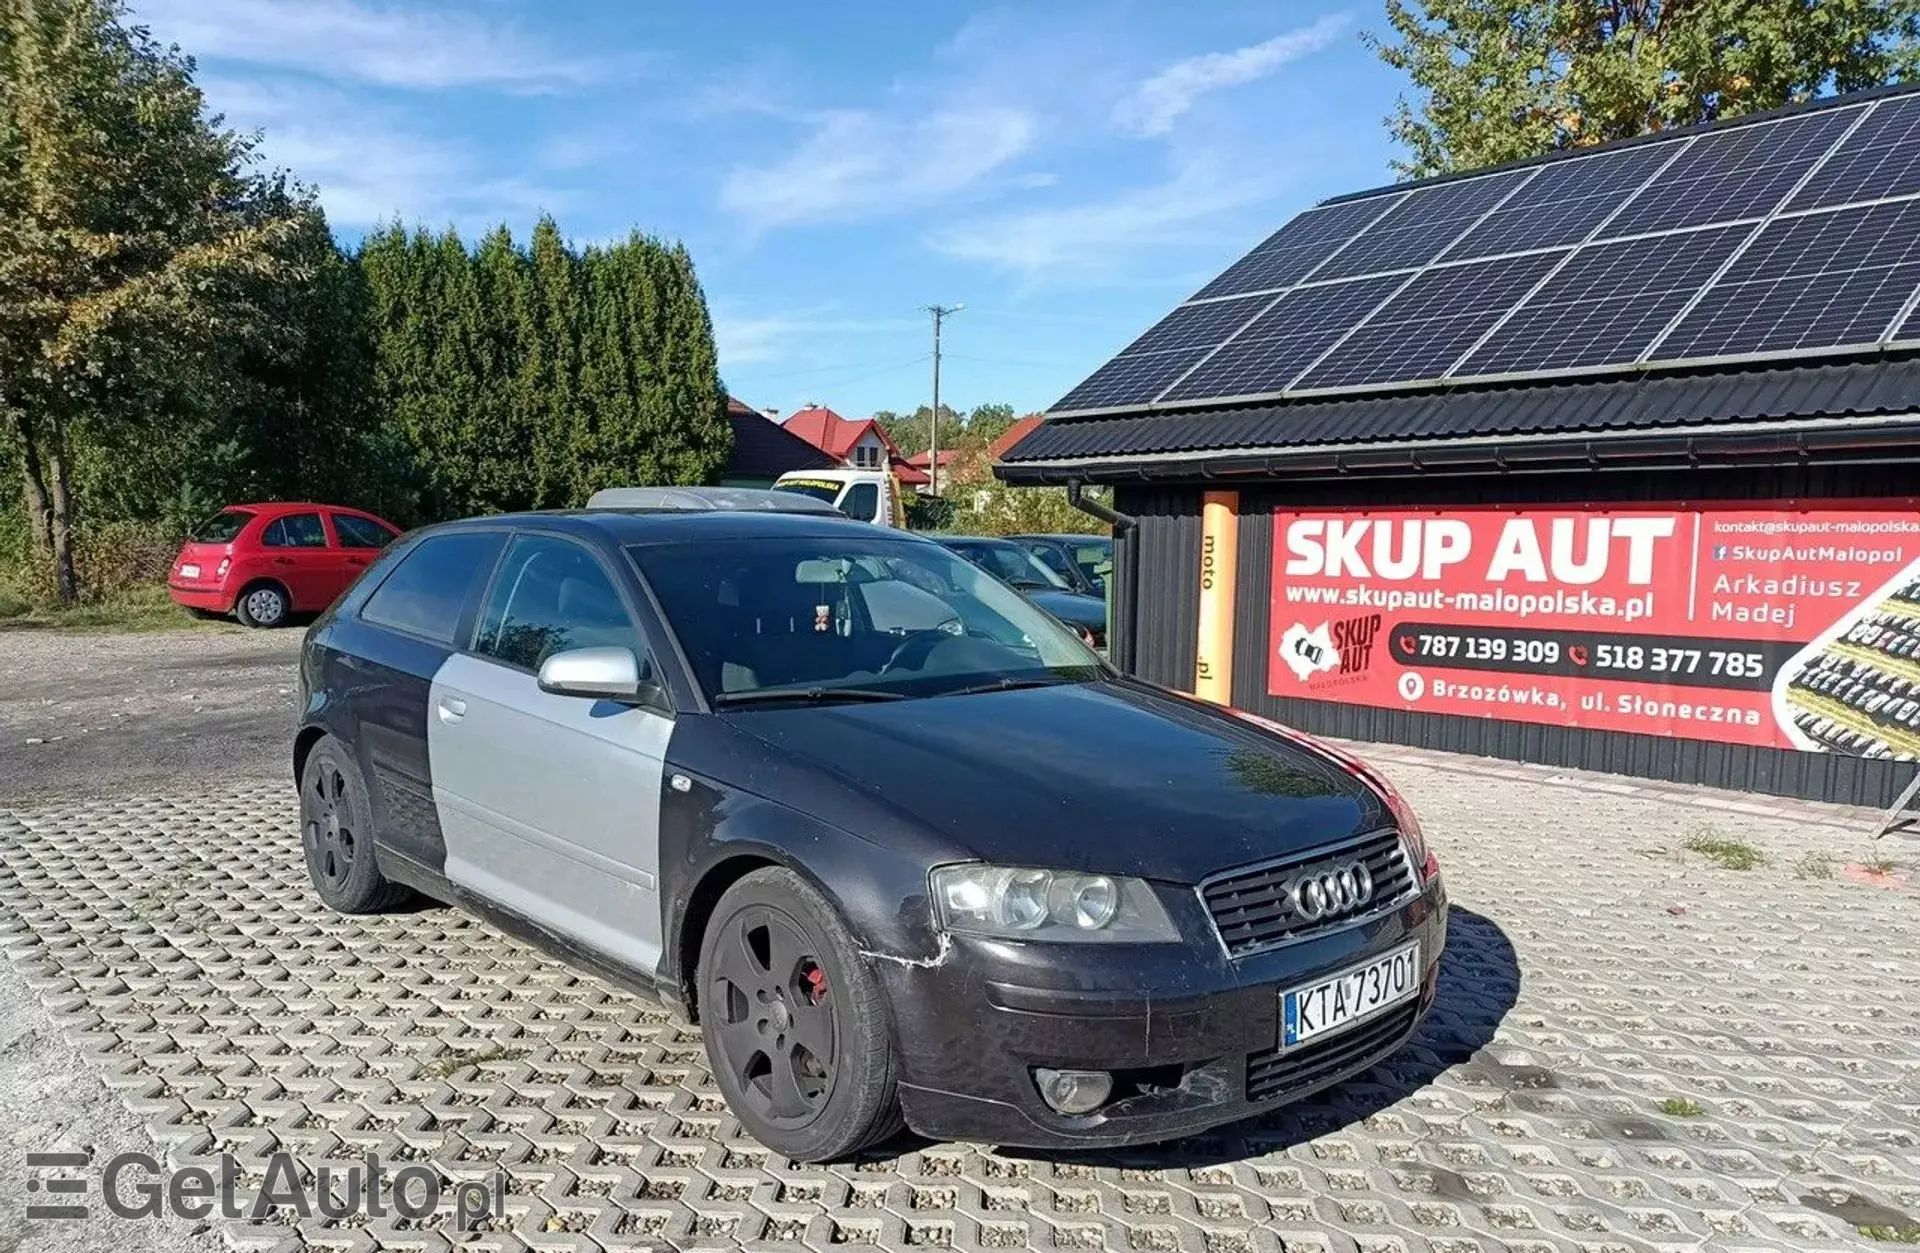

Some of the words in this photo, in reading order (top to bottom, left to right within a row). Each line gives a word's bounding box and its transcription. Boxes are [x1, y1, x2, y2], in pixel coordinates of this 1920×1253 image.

[1715, 521, 1920, 535] kontakt@skupaut-malopolska
[1203, 535, 1215, 590] moto
[1285, 519, 1471, 580] SKUP
[1485, 518, 1676, 584] AUT
[1732, 546, 1902, 564] SkupAutMalopol
[1713, 574, 1861, 597] Arkadiusz
[1286, 584, 1654, 621] www.skupaut-malopolska.pl
[1712, 601, 1796, 628] Madej
[1334, 613, 1381, 650] SKUP
[1340, 644, 1373, 675] AUT
[1419, 635, 1461, 656] 787
[1465, 637, 1507, 660] 139
[1512, 640, 1560, 663] 309
[1596, 645, 1644, 670] 518
[1650, 648, 1702, 673] 377
[1708, 651, 1764, 677] 785
[1197, 656, 1213, 680] .pl
[1432, 678, 1567, 710] Brzozówka,
[1581, 692, 1611, 712] ul.
[1617, 694, 1761, 726] Słoneczna
[1299, 980, 1347, 1034] KTA
[1353, 949, 1413, 1012] 73701
